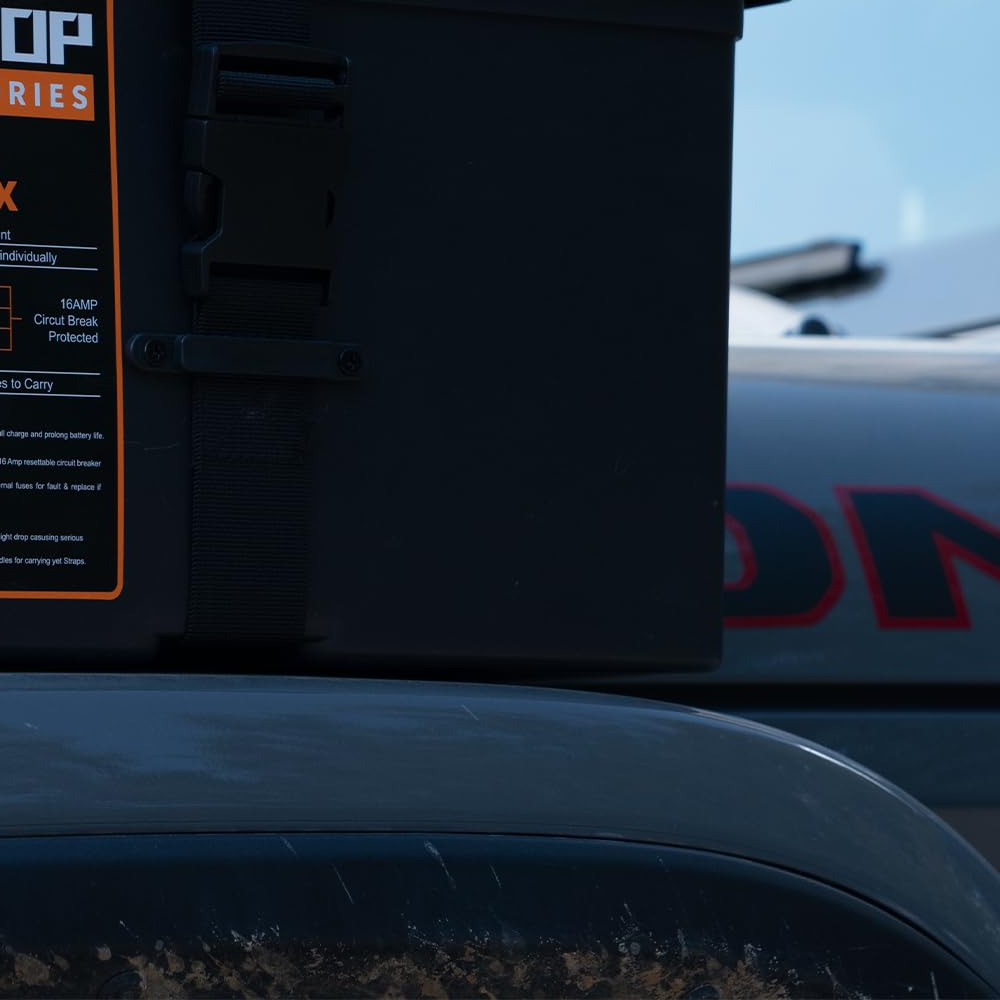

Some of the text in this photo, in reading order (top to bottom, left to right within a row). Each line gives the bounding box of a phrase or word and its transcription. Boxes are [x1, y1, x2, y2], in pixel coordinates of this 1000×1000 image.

[0, 249, 57, 265] individually
[60, 298, 97, 310] 16AMP
[33, 314, 98, 326] Circut Break
[48, 331, 98, 343] Protected
[10, 377, 21, 388] to
[24, 377, 53, 392] Carry
[6, 429, 28, 439] charge
[30, 430, 42, 438] and
[44, 430, 68, 440] prolong
[69, 431, 91, 441] battery
[23, 458, 55, 466] resettable
[56, 458, 75, 466] circuit
[15, 481, 33, 489] fuses
[70, 482, 94, 492] replace
[13, 533, 28, 542] drop
[59, 533, 83, 541] serious
[24, 556, 50, 565] carrying
[51, 556, 62, 566] yet
